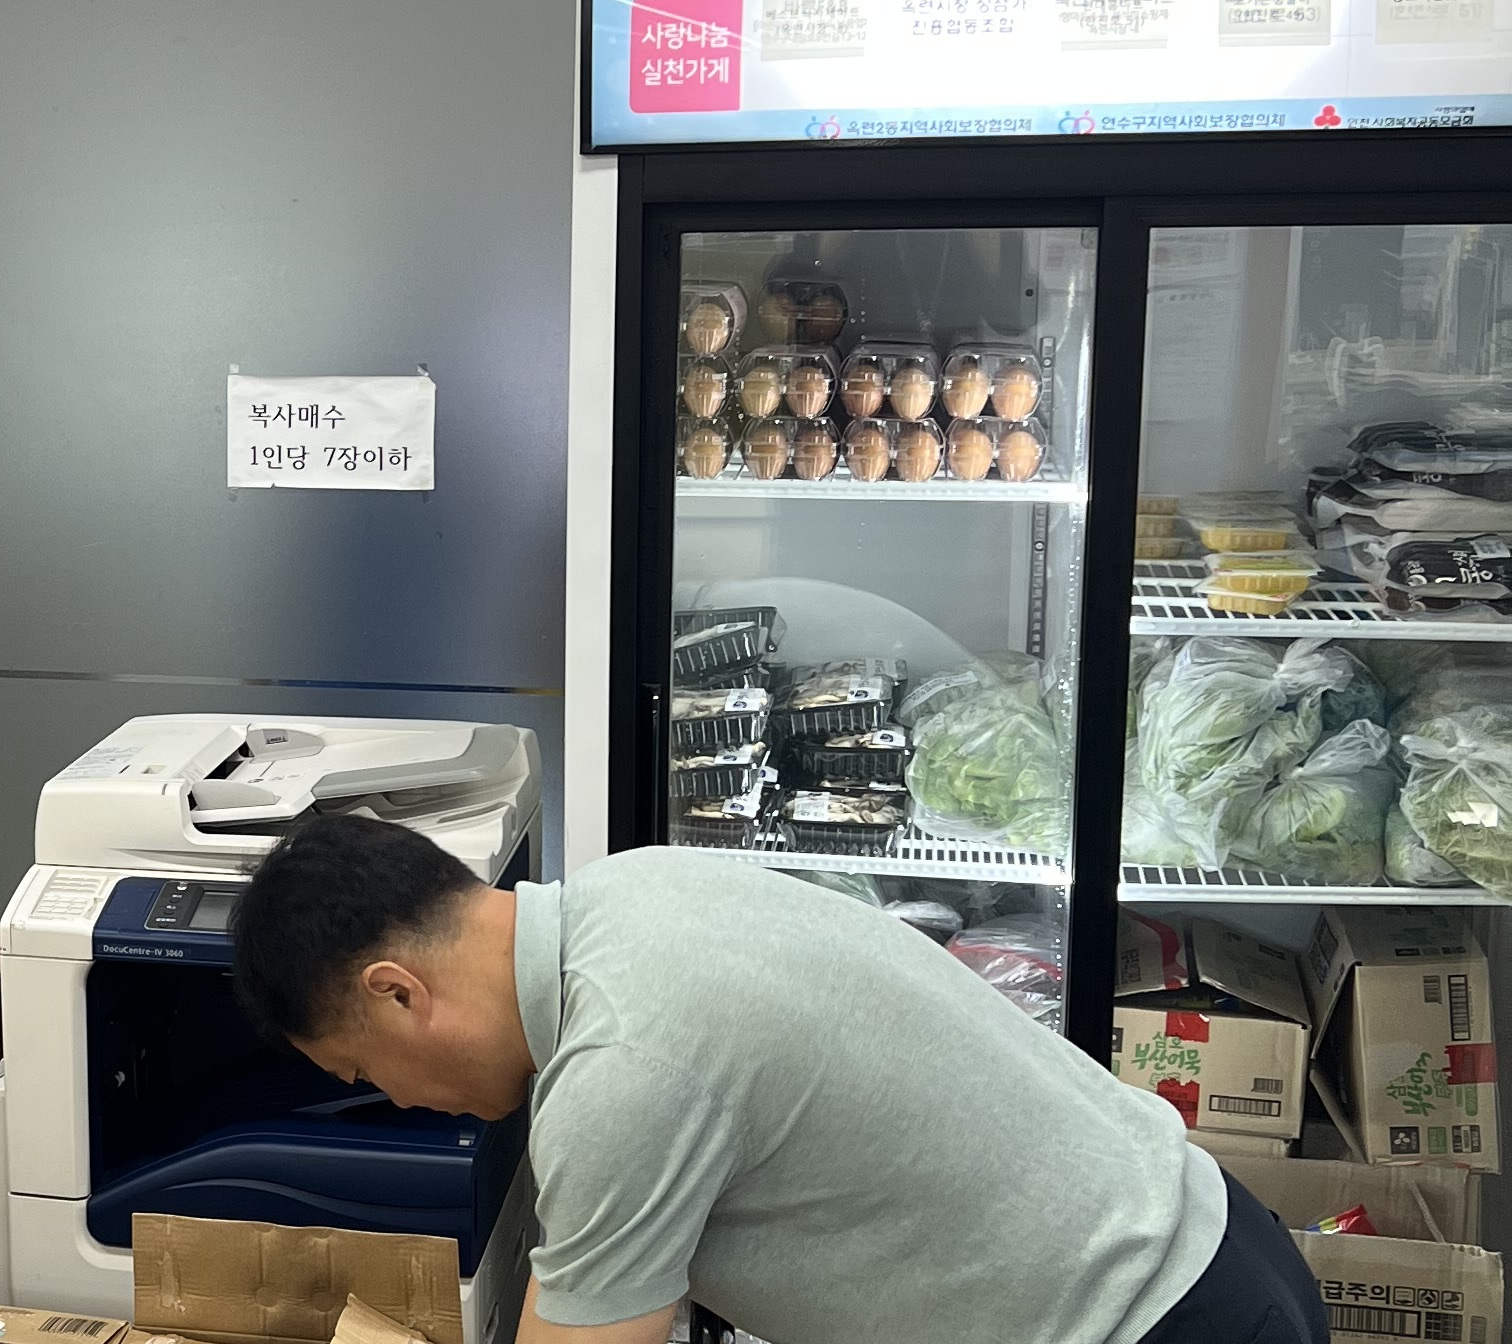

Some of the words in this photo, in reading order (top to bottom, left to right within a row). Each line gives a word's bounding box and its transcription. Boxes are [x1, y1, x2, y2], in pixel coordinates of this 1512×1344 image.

[640, 22, 729, 51] 사랑나눔
[912, 17, 1014, 35] 진흥협동조합
[640, 58, 730, 86] 실천가게
[846, 117, 1033, 136] 옥련2동지역사회보장협의체
[1101, 112, 1286, 132] 연수구지역사회보장협의체
[248, 403, 346, 429] 복사매수
[250, 444, 311, 470] 1인당
[323, 445, 412, 471] 7장이하
[1131, 1042, 1201, 1076] 부산어묵
[1319, 1279, 1391, 1305] 급주의
